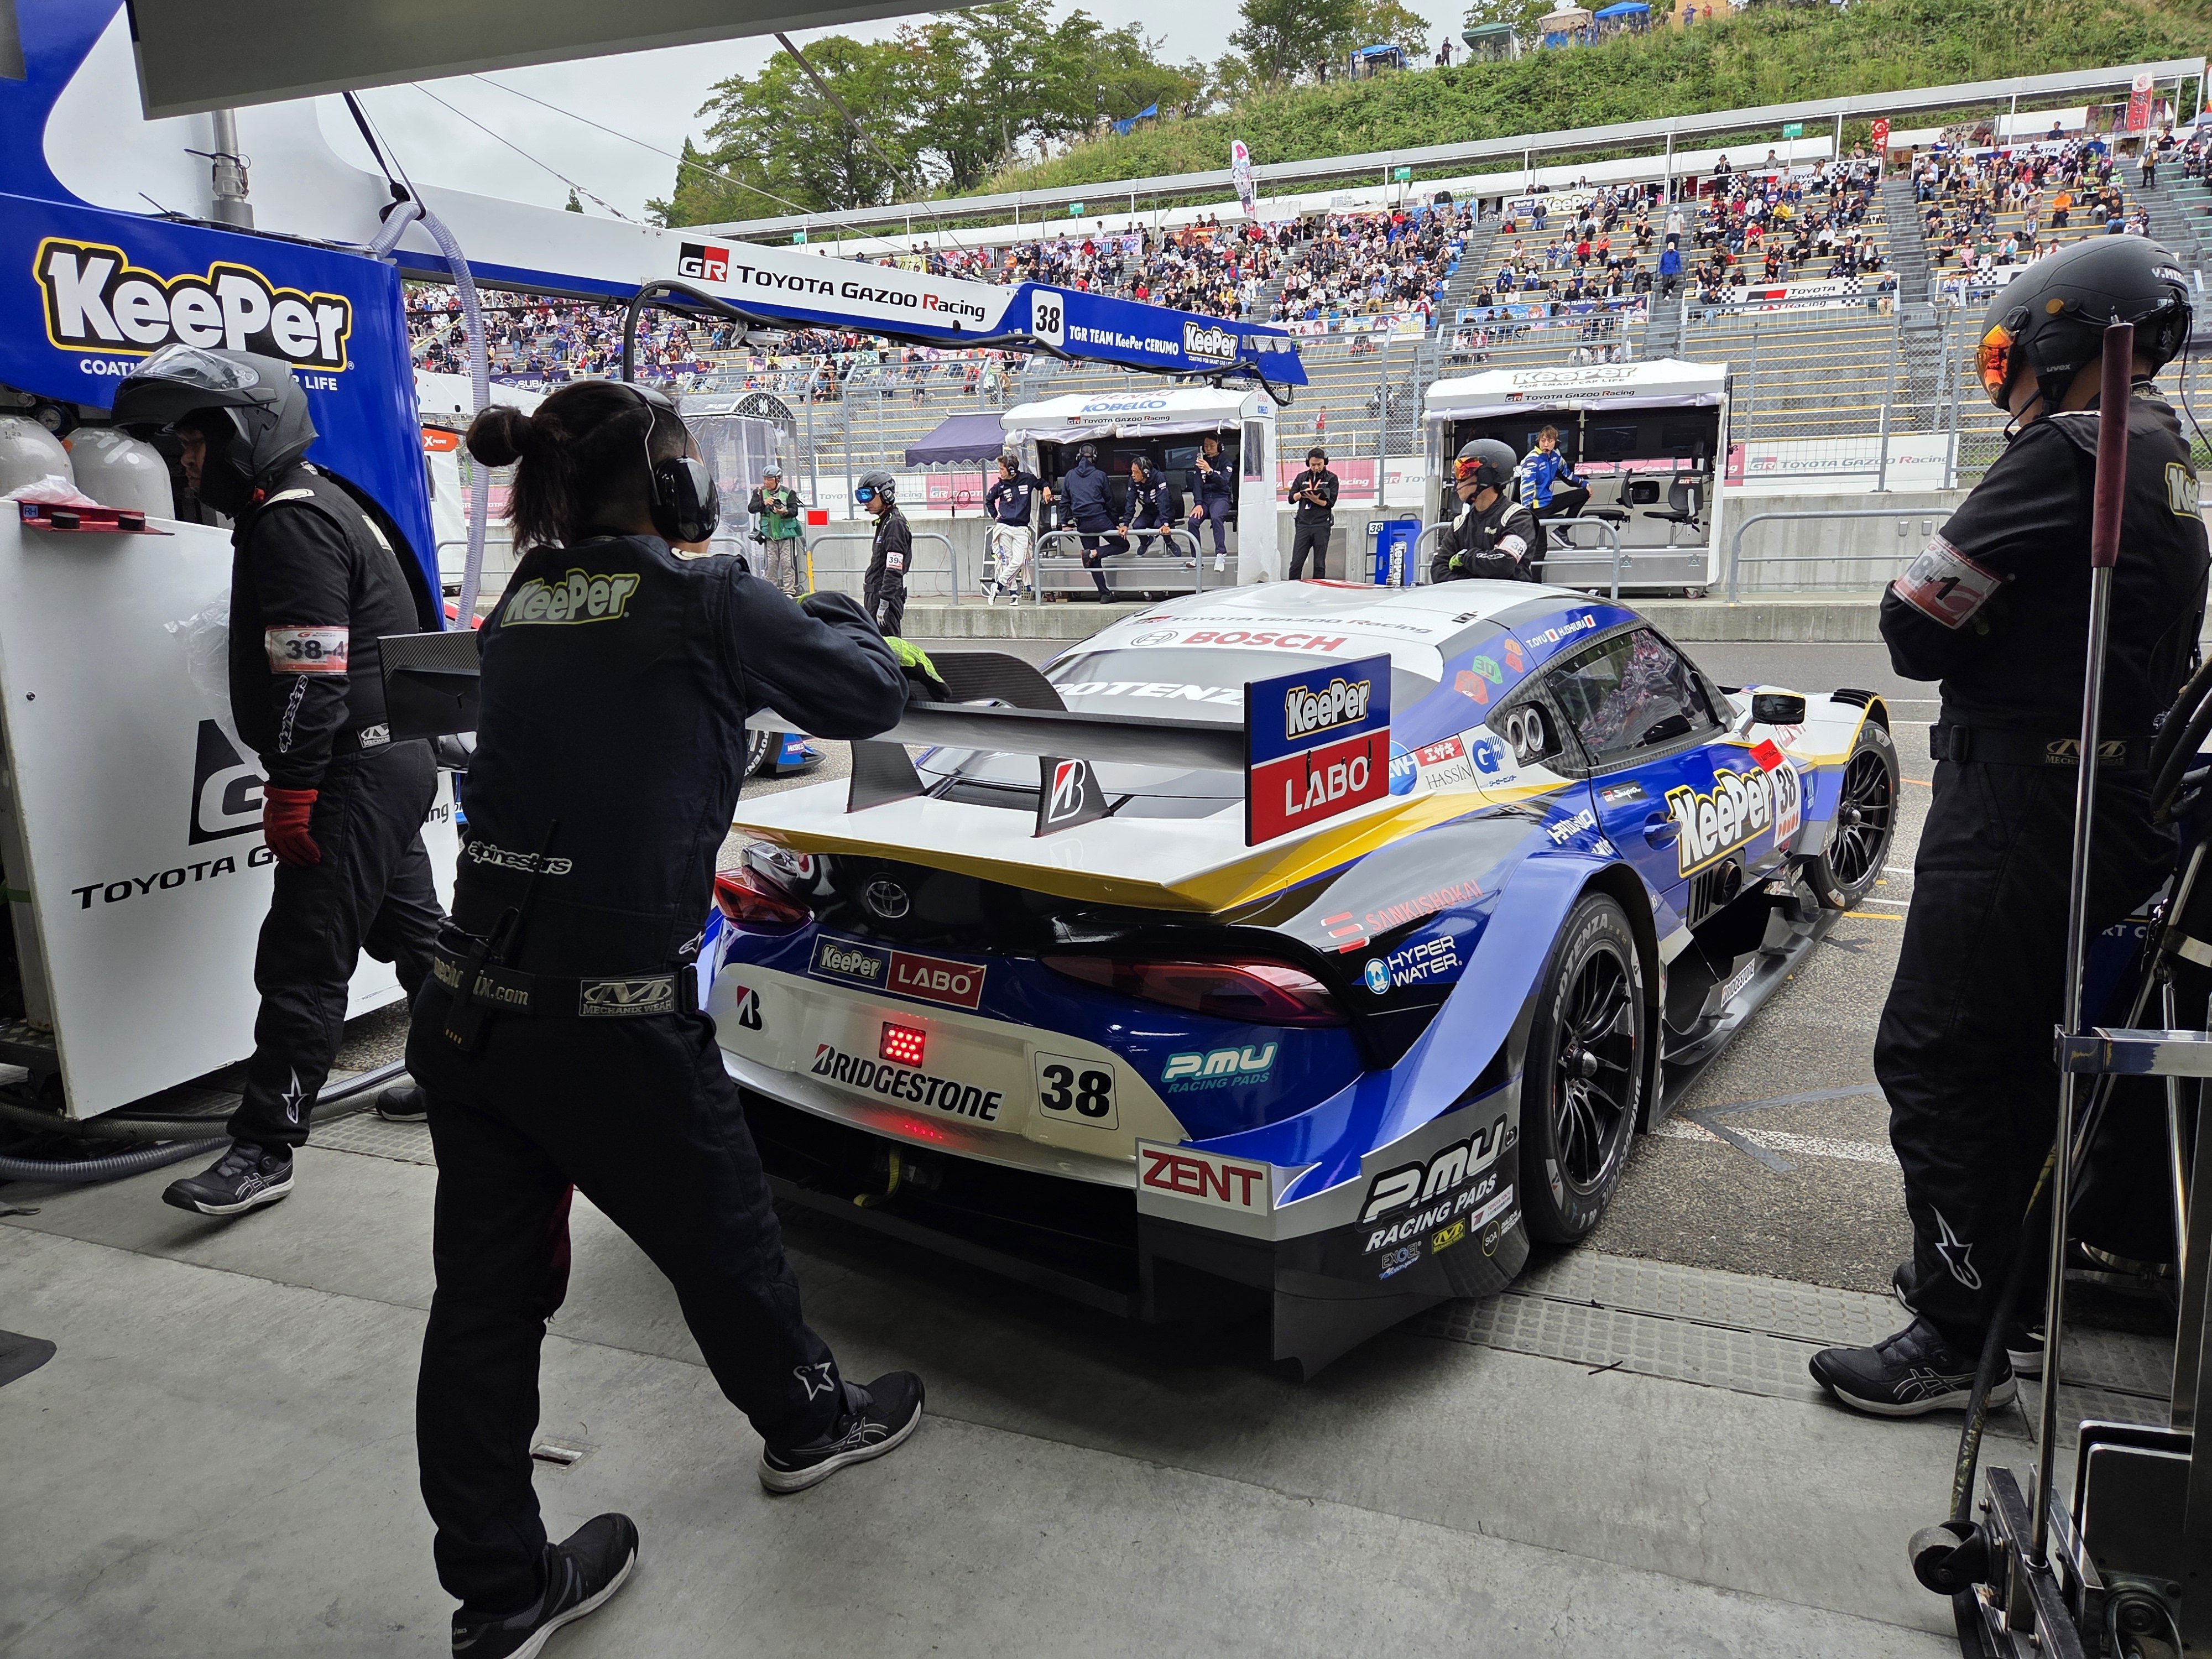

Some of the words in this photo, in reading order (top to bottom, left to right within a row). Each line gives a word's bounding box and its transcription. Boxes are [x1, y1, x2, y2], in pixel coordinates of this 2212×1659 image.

[1235, 144, 1246, 159] 4
[1543, 195, 1595, 212] KeePe
[679, 253, 728, 281] GR
[737, 265, 834, 295] TOYOTA
[842, 283, 917, 307] GAZOO
[922, 294, 985, 322] Racing
[1791, 286, 1836, 294] TOYOTA
[48, 251, 343, 361] KeePer
[1785, 300, 1827, 309] Racing
[1036, 305, 1061, 333] 38
[1070, 325, 1087, 342] TGR
[1089, 328, 1113, 346] TEAM
[1115, 333, 1143, 350] KeePer
[1145, 338, 1178, 355] CERUMO
[1185, 324, 1236, 357] KeePer
[80, 359, 140, 376] COATI
[1514, 368, 1637, 384] KeePer
[2047, 363, 2070, 372] uvex
[305, 375, 337, 390] LIFE
[759, 398, 769, 414] 96
[1081, 400, 1167, 413] KOBELCO
[1505, 393, 1523, 402] GR
[1750, 459, 1777, 471] GR
[1782, 460, 1837, 468] TOYOTA
[1338, 477, 1370, 487] acing
[2169, 467, 2200, 517] Kee
[930, 488, 948, 498] GR
[24, 507, 36, 515] RH
[1369, 524, 1383, 533] 38
[504, 574, 635, 622] KeePer
[1257, 616, 1343, 624] GAZOO
[1345, 619, 1433, 634] Racing
[1526, 634, 1547, 649] T.OYU
[1558, 620, 1587, 637] H.ISHIURA
[285, 640, 344, 660] 38-4
[1180, 631, 1348, 652] BOSCH
[1476, 659, 1495, 676] 30
[1053, 681, 1244, 708] POTENZ
[1287, 681, 1368, 735] KeePer
[363, 735, 390, 747] MECHAN
[1423, 742, 1456, 762] エザキ
[1286, 756, 1370, 817] LABO
[1614, 786, 1642, 800] Supra
[1775, 764, 1797, 814] 38
[1672, 772, 1770, 868] KeePer
[72, 855, 236, 910] TOYOTA
[1365, 878, 1484, 932] SANKISHOKAI
[1387, 935, 1455, 971] HYPER
[821, 944, 881, 978] KeePer
[898, 963, 972, 995] LABO
[1392, 952, 1458, 988] WATER
[1552, 913, 1609, 1025] POTENZA
[583, 1003, 643, 1015] MECHANIX
[644, 999, 673, 1013] WEAR
[811, 1044, 1002, 1122] BRIDGESTONE
[1041, 1065, 1113, 1118] 38
[1168, 1079, 1228, 1093] RACING
[1231, 1072, 1270, 1088] PADS
[1142, 1149, 1263, 1207] ZENT
[1365, 1200, 1452, 1253] RACING
[1454, 1172, 1497, 1214] PADS
